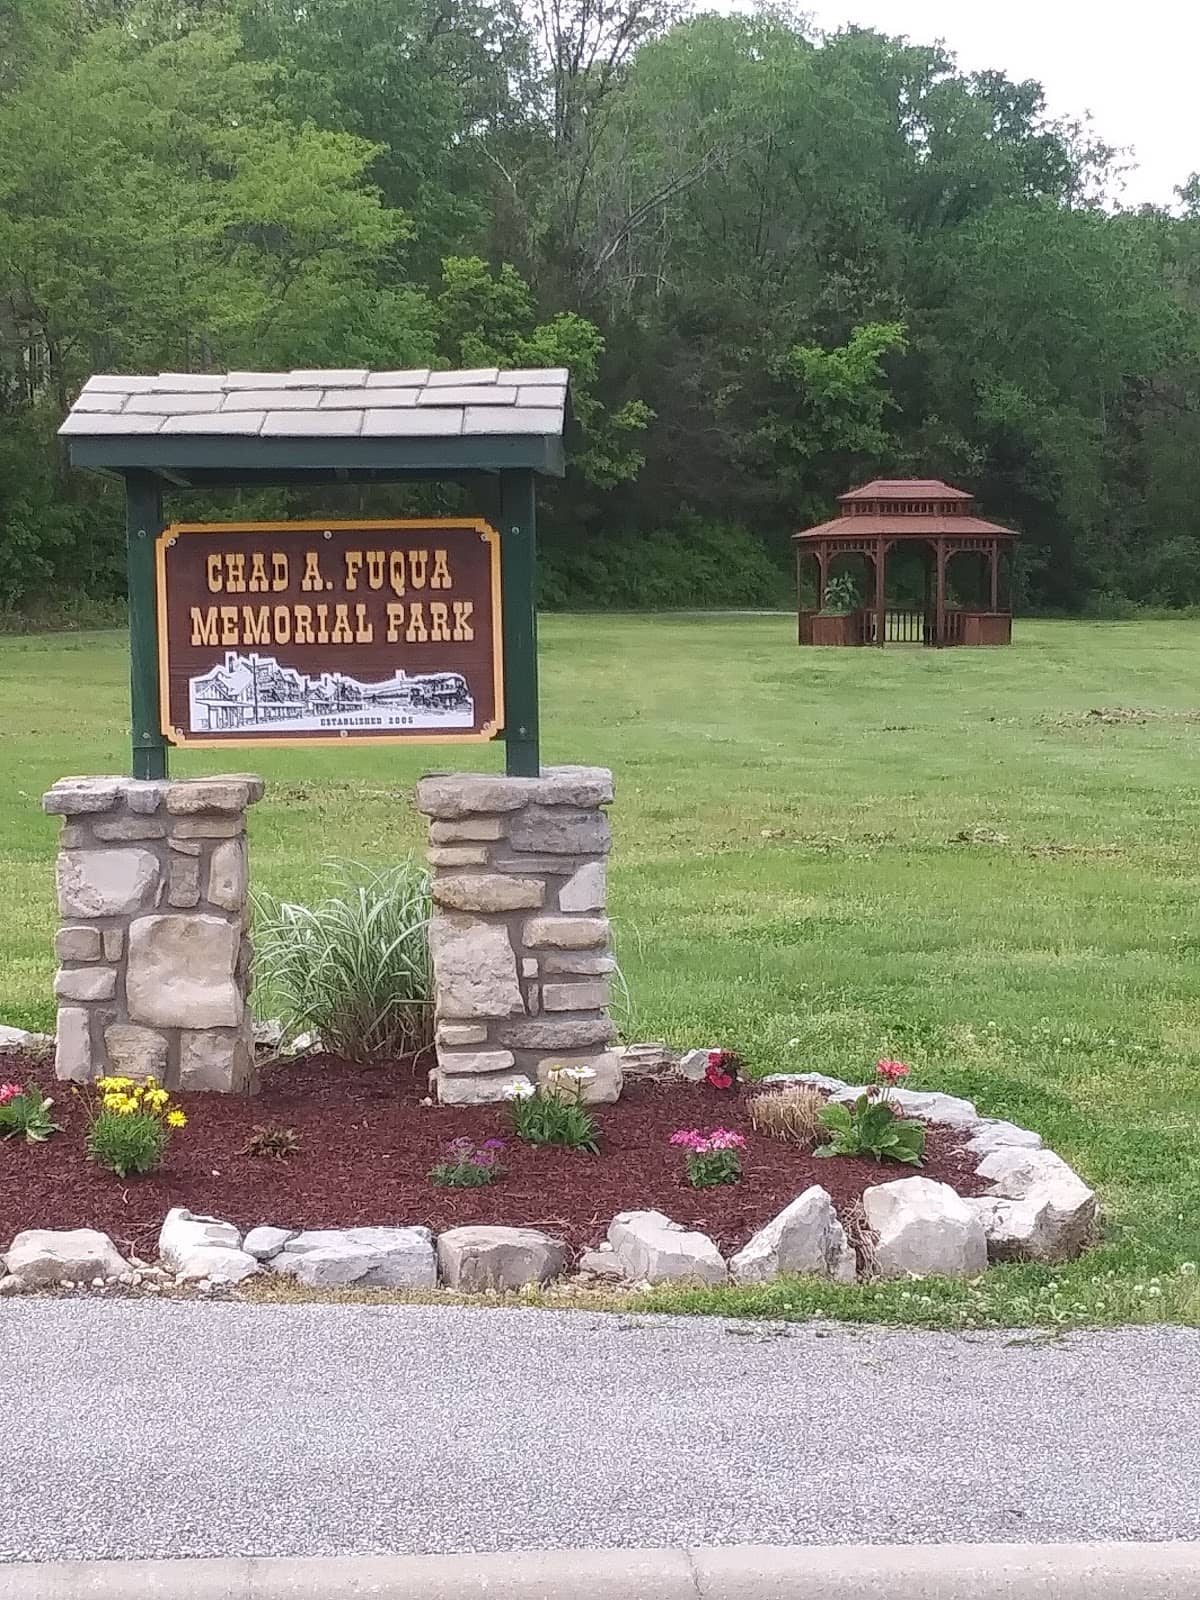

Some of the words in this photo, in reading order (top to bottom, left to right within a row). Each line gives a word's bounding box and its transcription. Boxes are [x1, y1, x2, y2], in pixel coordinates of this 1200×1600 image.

[207, 553, 290, 593] CHAD
[302, 552, 333, 591] A.
[345, 550, 452, 597] FUQUA
[191, 604, 374, 645] MEMORIAL
[386, 601, 474, 642] PARK
[320, 717, 382, 726] ESTABLISHED
